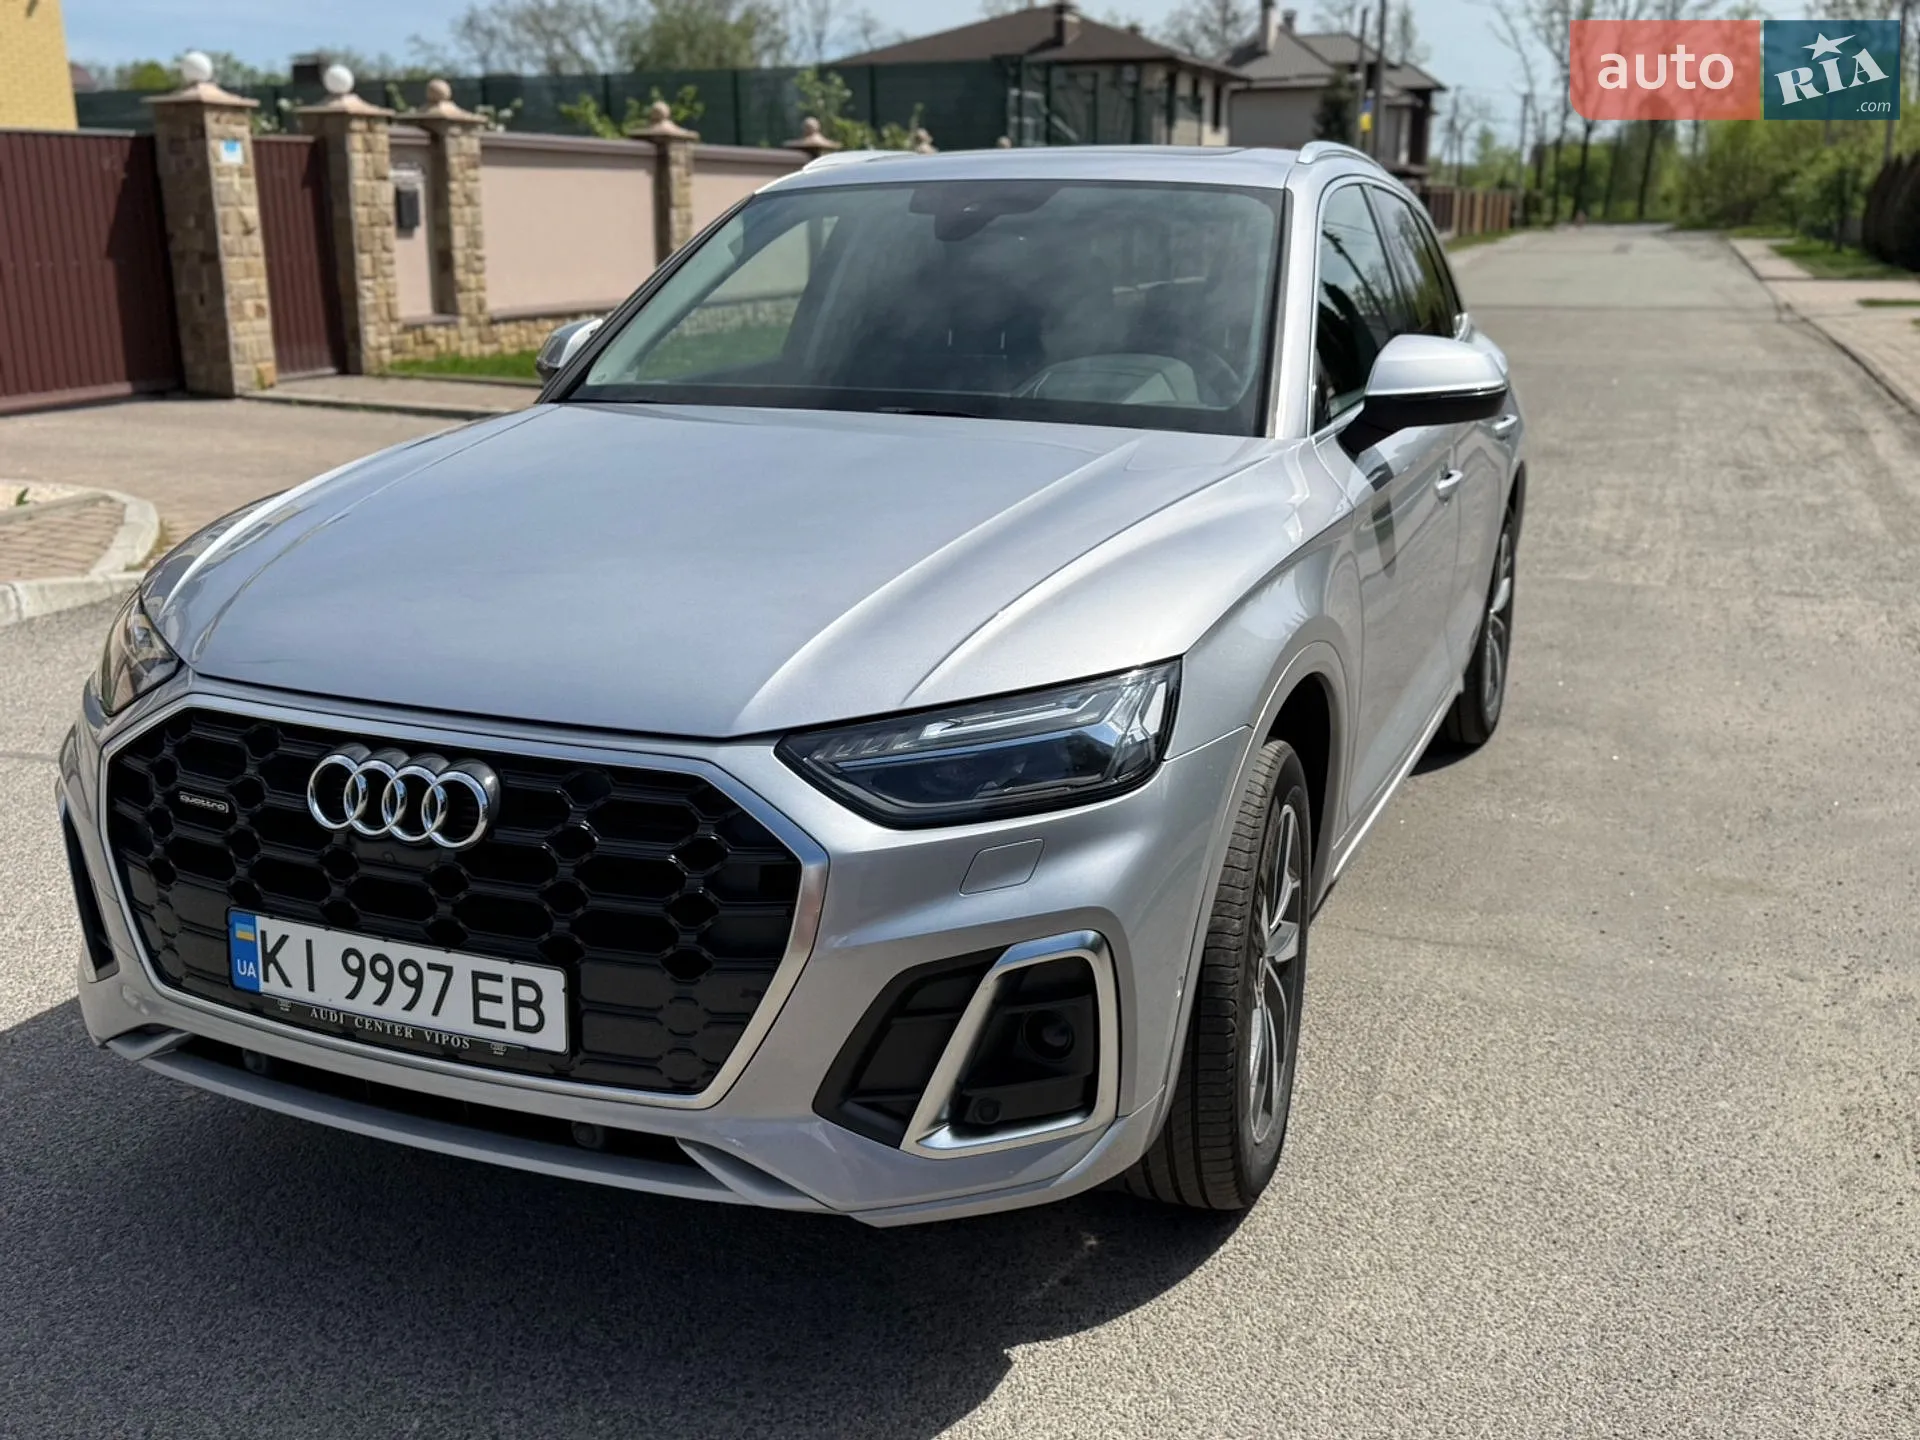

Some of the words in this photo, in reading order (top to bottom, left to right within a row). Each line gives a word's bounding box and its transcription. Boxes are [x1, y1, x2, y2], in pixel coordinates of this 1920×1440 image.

[236, 958, 257, 979] UA
[260, 930, 315, 993] KI
[341, 947, 453, 1017] 9997
[471, 970, 546, 1035] EB
[310, 1006, 345, 1025] AUDI
[354, 1016, 413, 1039] CENTER
[424, 1030, 471, 1050] VIPOS
